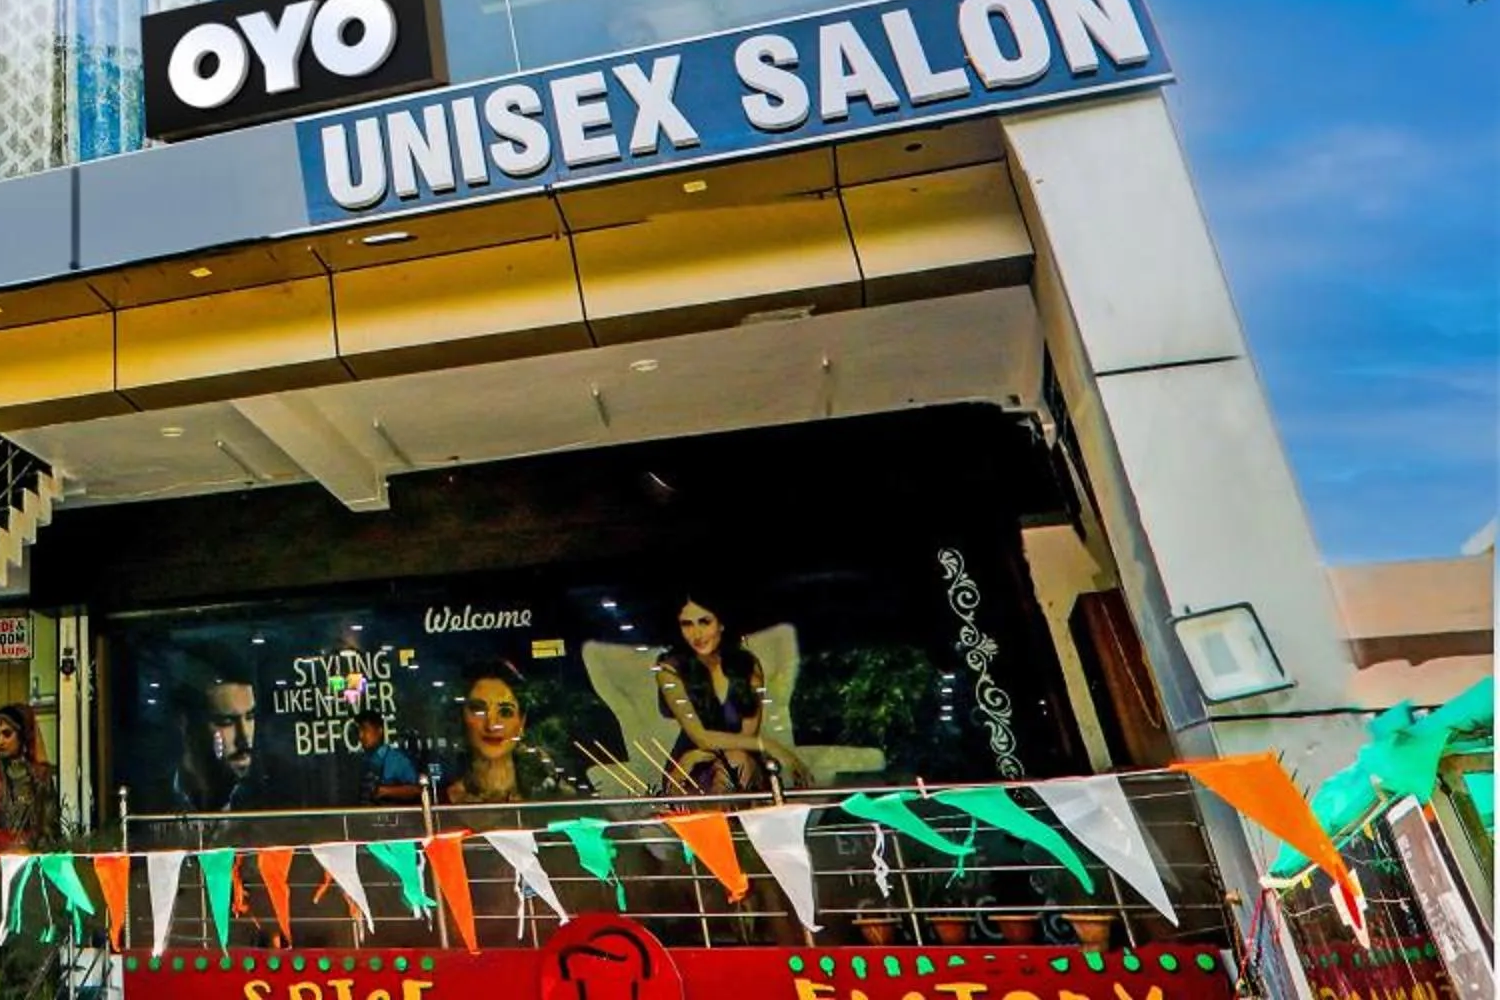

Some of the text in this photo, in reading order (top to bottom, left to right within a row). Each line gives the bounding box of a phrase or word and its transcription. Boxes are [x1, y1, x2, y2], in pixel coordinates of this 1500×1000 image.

[321, 54, 700, 210] UNISEX
[424, 605, 532, 633] Welcome
[295, 714, 398, 756] BEFOE
